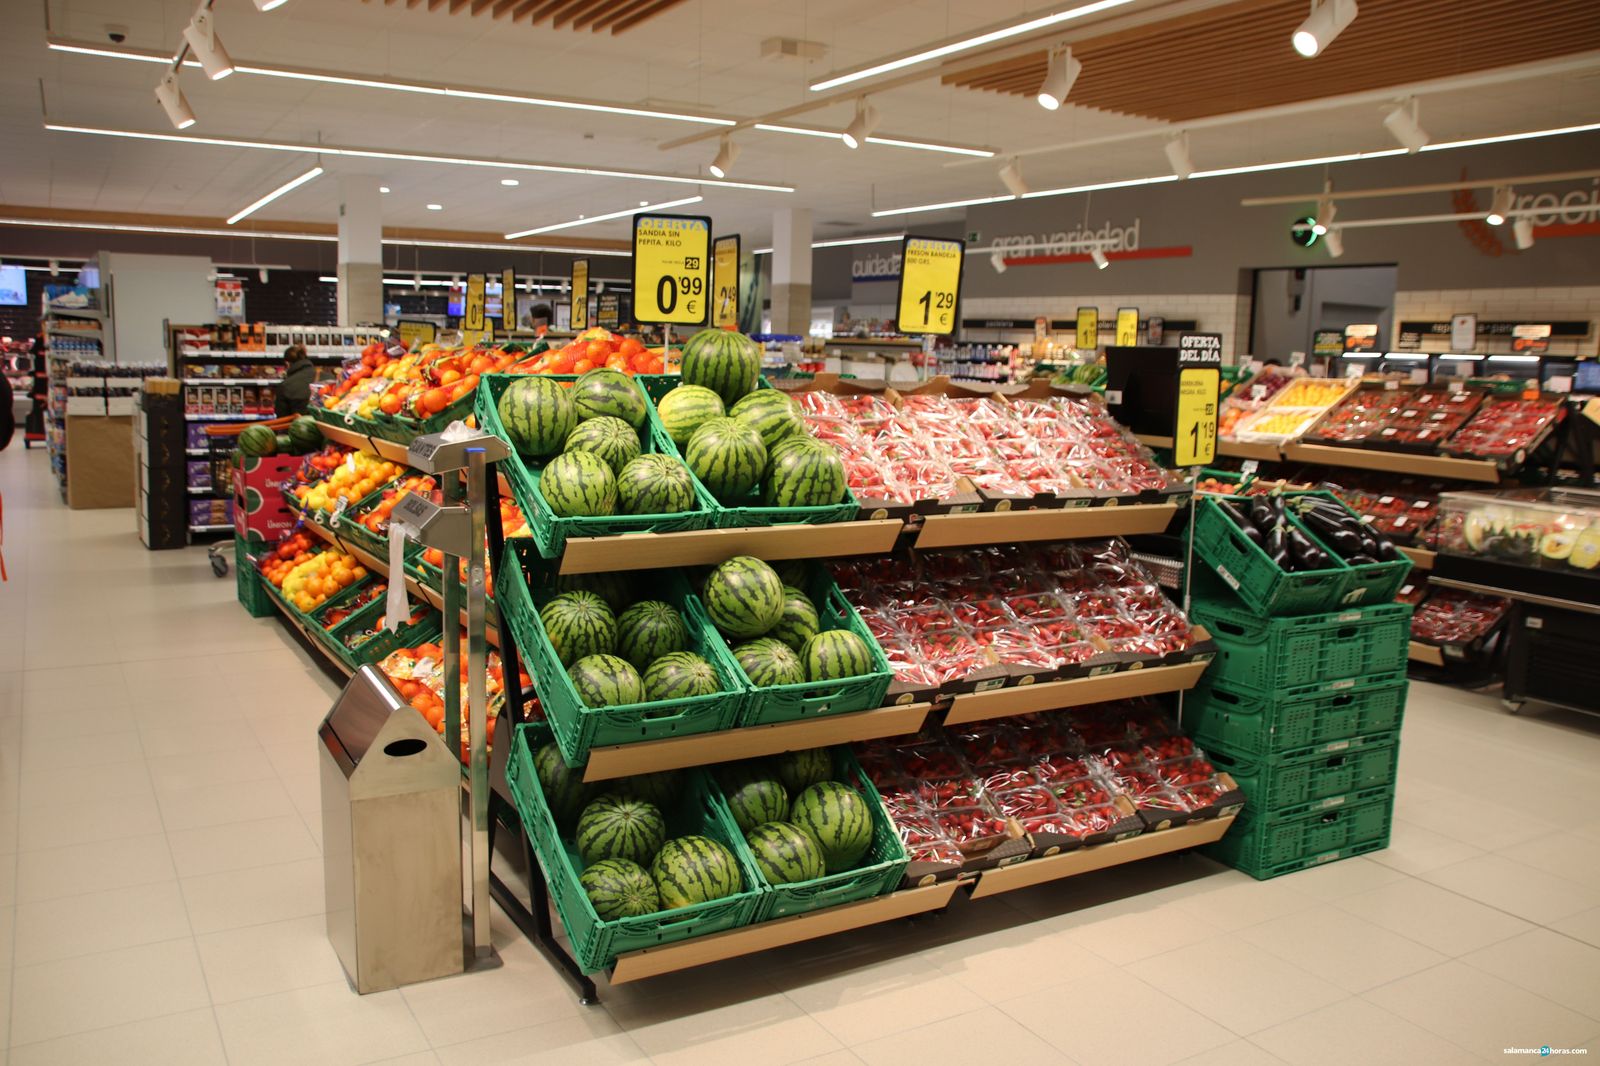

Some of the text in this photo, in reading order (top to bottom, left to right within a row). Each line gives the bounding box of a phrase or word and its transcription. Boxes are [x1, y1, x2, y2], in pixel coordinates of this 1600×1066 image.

[638, 229, 680, 238] SANDIA SIN
[1042, 218, 1140, 256] variedad
[665, 239, 682, 248] KILO
[685, 258, 699, 269] 29
[1181, 336, 1220, 349] OFERTA
[1180, 347, 1220, 362] DEL DÍA
